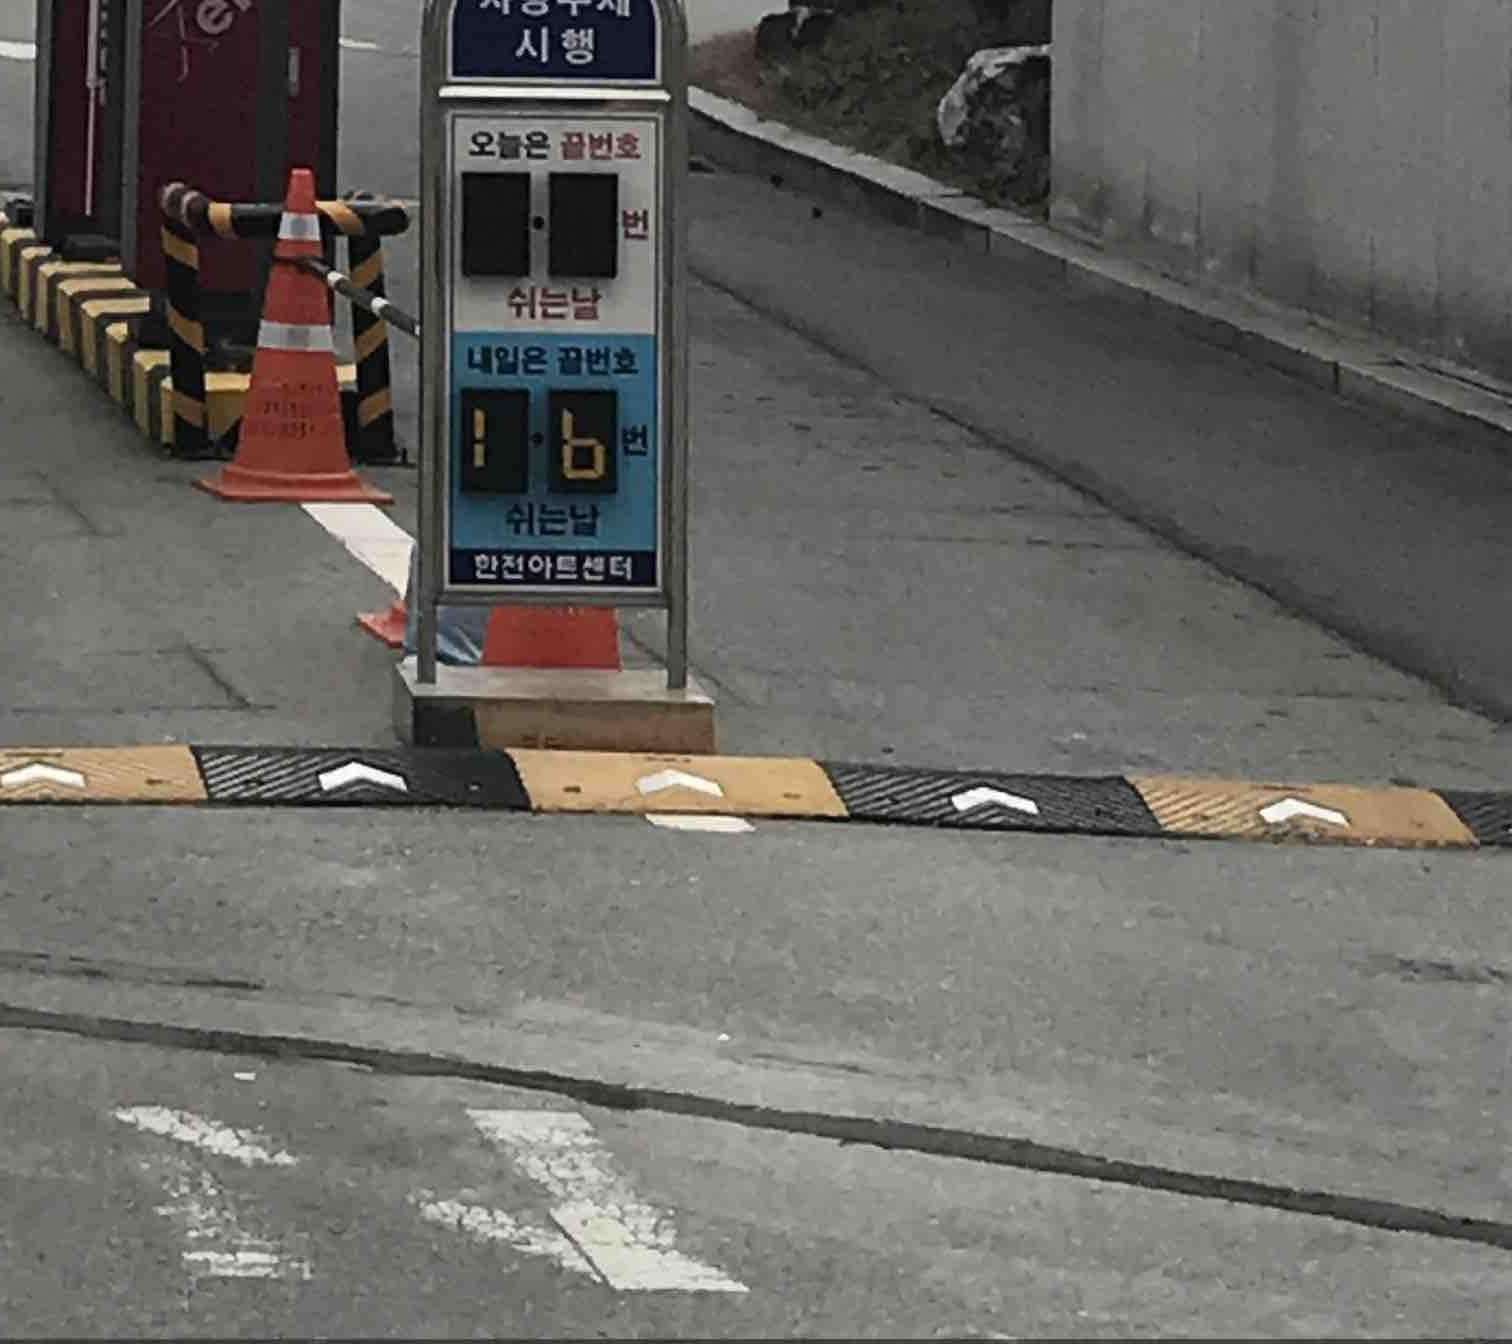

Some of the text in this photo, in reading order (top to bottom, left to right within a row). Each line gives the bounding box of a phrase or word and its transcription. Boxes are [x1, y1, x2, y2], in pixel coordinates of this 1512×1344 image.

[468, 131, 550, 160] 오늘은
[622, 209, 649, 240] 번
[508, 289, 601, 321] 쉬는날
[468, 346, 548, 376] 내일은
[623, 424, 648, 457] 번
[506, 503, 600, 537] 쉬는날
[474, 553, 633, 581] 한전아트센터
